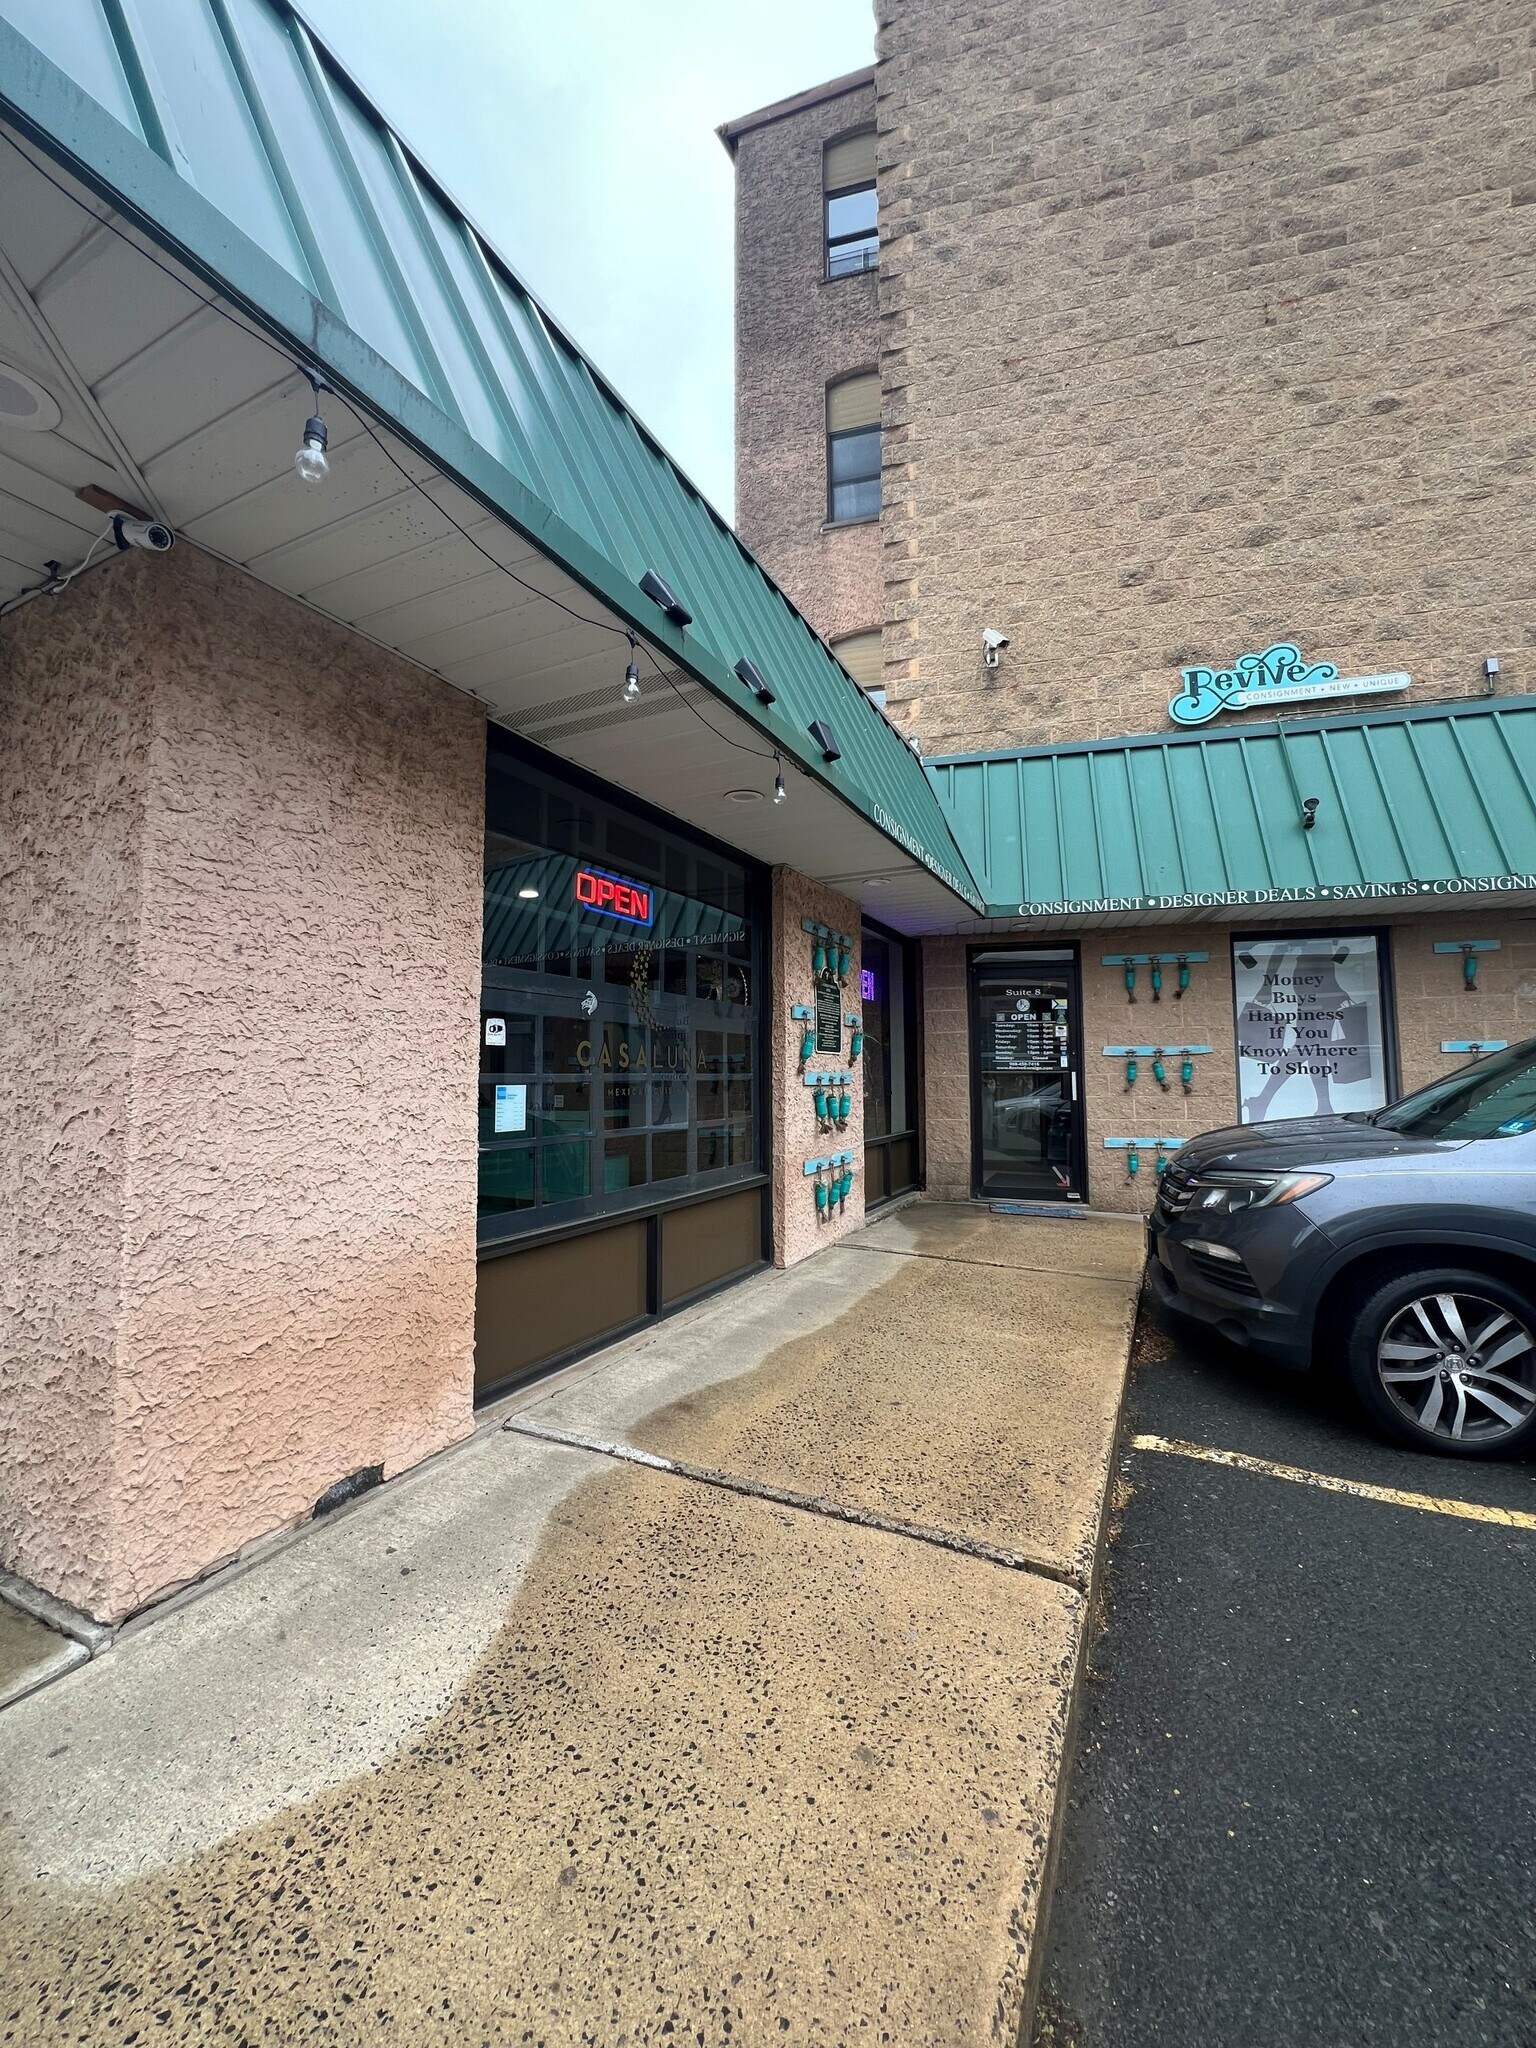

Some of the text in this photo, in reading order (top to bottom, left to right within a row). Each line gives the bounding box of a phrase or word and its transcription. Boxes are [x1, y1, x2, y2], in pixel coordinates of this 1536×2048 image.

[1173, 647, 1333, 721] Revive
[1246, 677, 1400, 701] CONSIGNMENT NEW UNIQUE
[873, 803, 925, 862] CONSIGNMENT
[576, 872, 648, 919] OPEN
[1018, 897, 1143, 917] CONSIGNMENT
[1159, 891, 1250, 909] DESIGNER
[1255, 886, 1316, 903] DEALS
[1263, 974, 1324, 988] Money
[1005, 988, 1041, 996] Suite 8
[1272, 991, 1317, 1006] Buys
[1010, 1013, 1037, 1021] OPEN
[1247, 1009, 1344, 1025] Happiness
[1268, 1026, 1328, 1040] If You
[1239, 1044, 1358, 1057] Know Where
[1257, 1061, 1339, 1078] To Shop!
